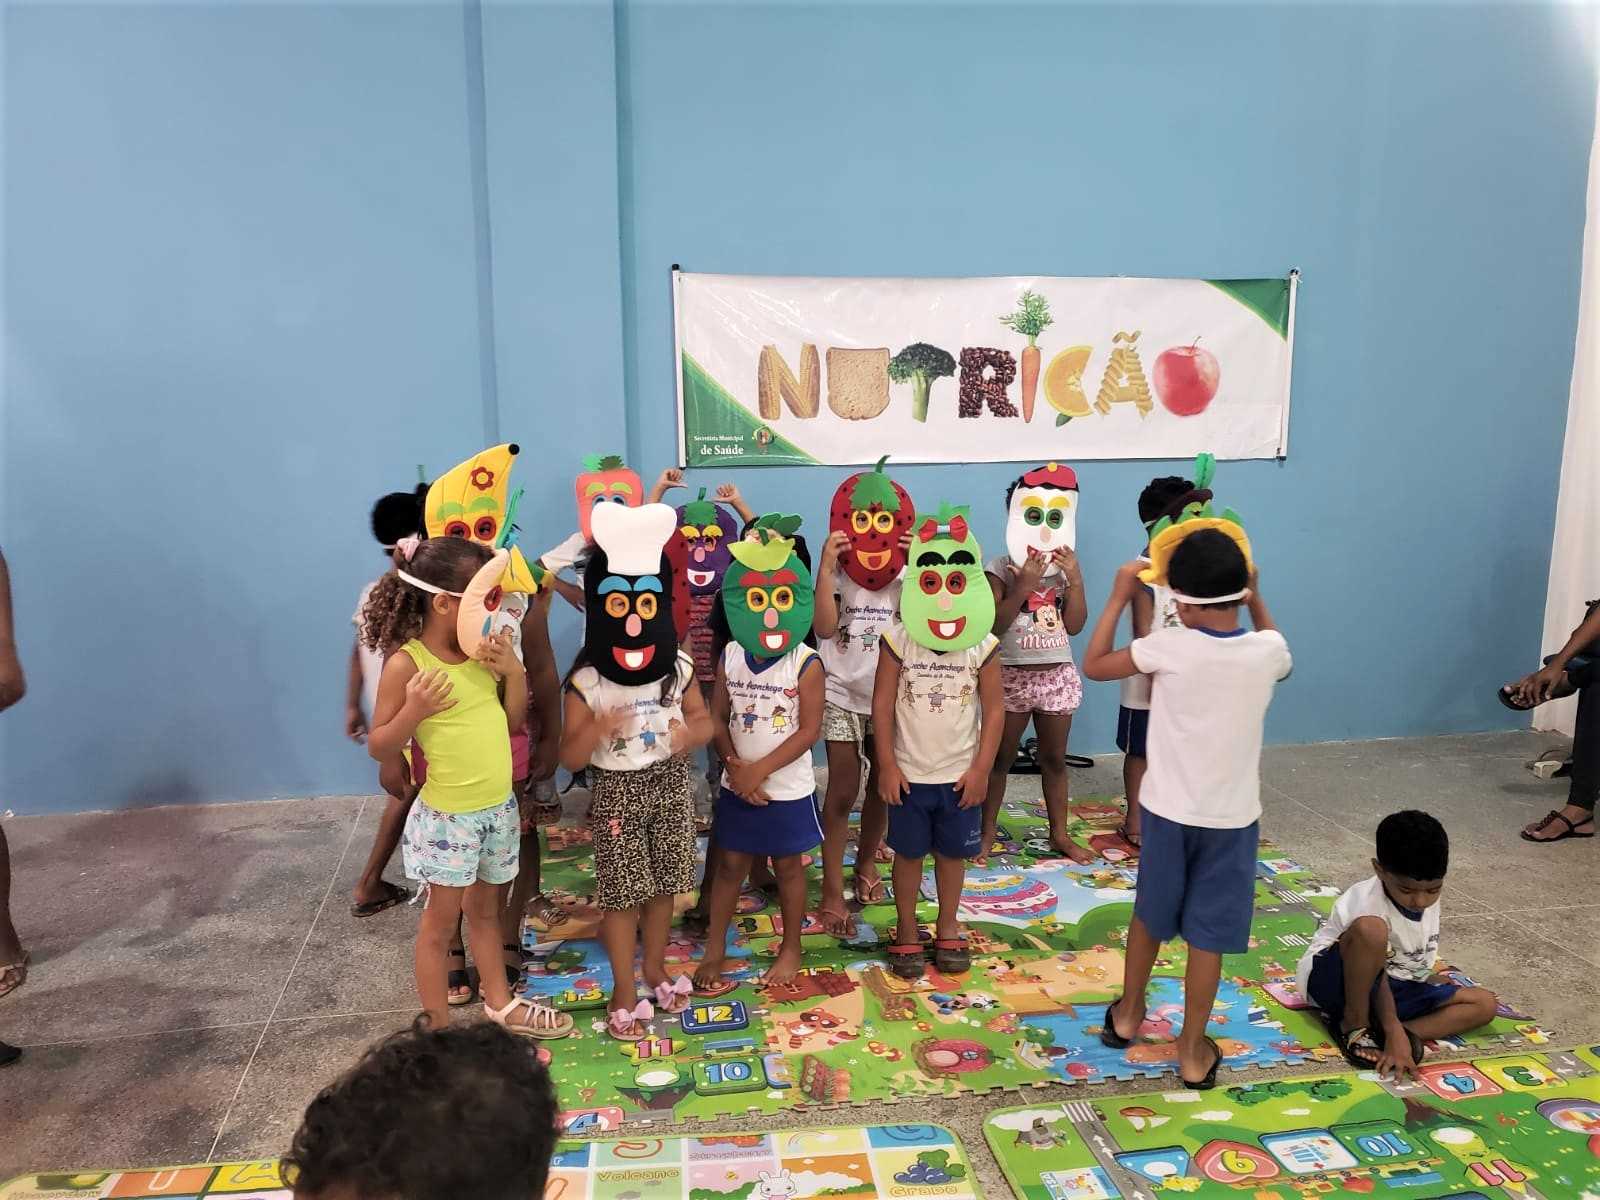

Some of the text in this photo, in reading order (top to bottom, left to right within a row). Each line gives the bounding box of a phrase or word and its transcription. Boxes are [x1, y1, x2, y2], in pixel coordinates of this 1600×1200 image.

[757, 291, 1221, 427] NUTRIÇÃO
[700, 445, 744, 455] de Saúde
[693, 1005, 734, 1024] 12
[634, 1037, 673, 1058] 11
[704, 1061, 752, 1084] 10
[1441, 1072, 1475, 1094] 4
[1355, 1132, 1413, 1158] 10
[597, 1169, 680, 1182] Volcano
